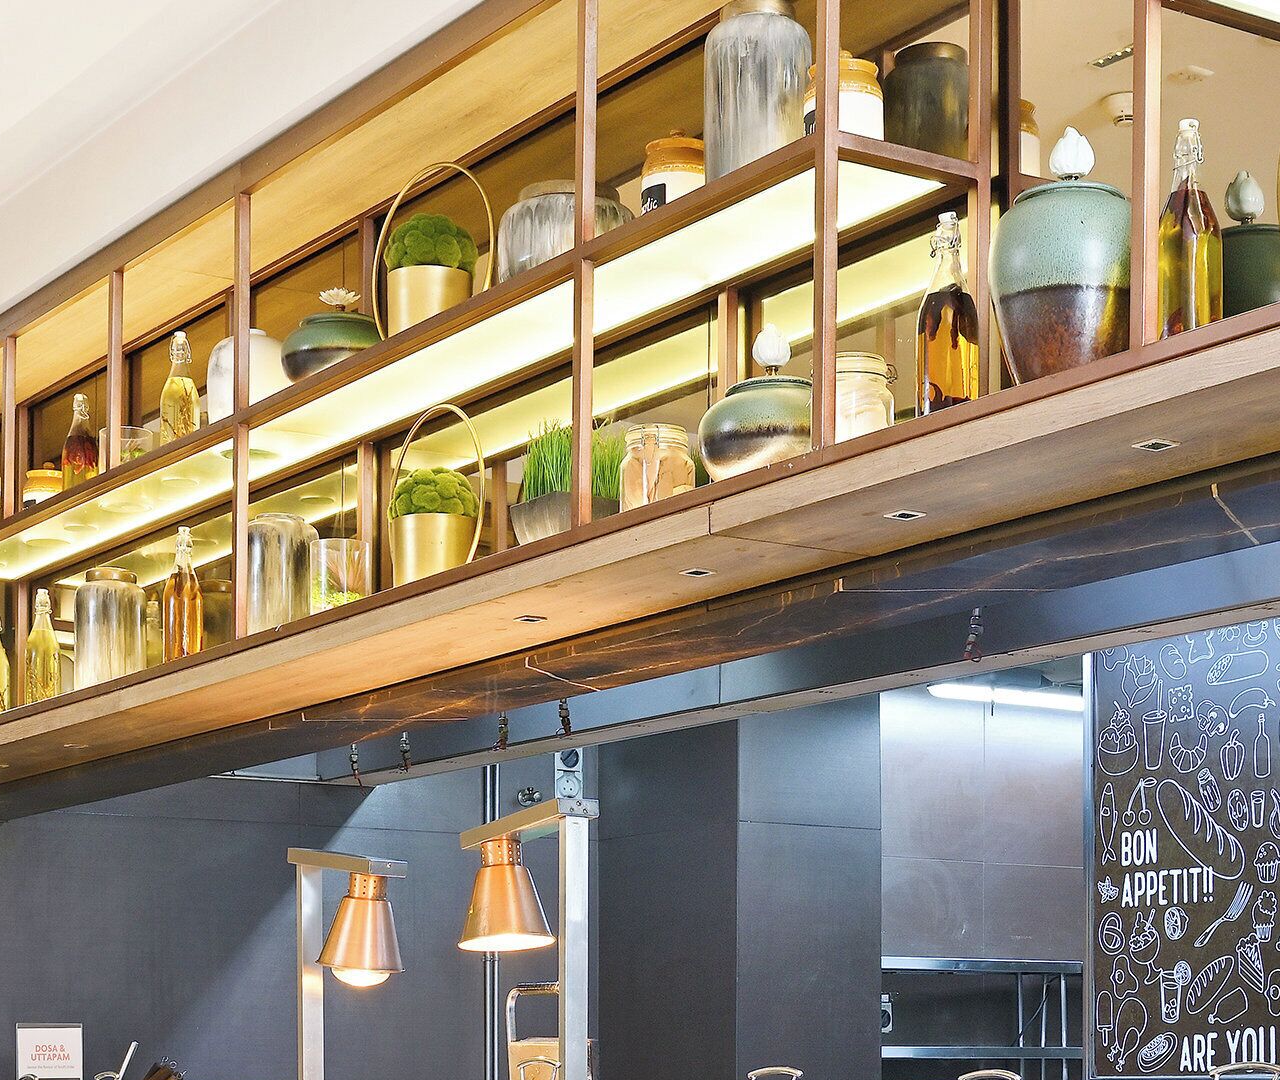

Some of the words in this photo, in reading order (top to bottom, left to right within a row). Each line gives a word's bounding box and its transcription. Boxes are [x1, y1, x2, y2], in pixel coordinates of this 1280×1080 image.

[1121, 827, 1158, 867] BON
[1121, 866, 1214, 908] APPETIT!!
[31, 1053, 70, 1061] UTTAPAM
[60, 1044, 66, 1052] &
[1179, 1032, 1218, 1073] ARE
[1226, 1025, 1276, 1073] YOU
